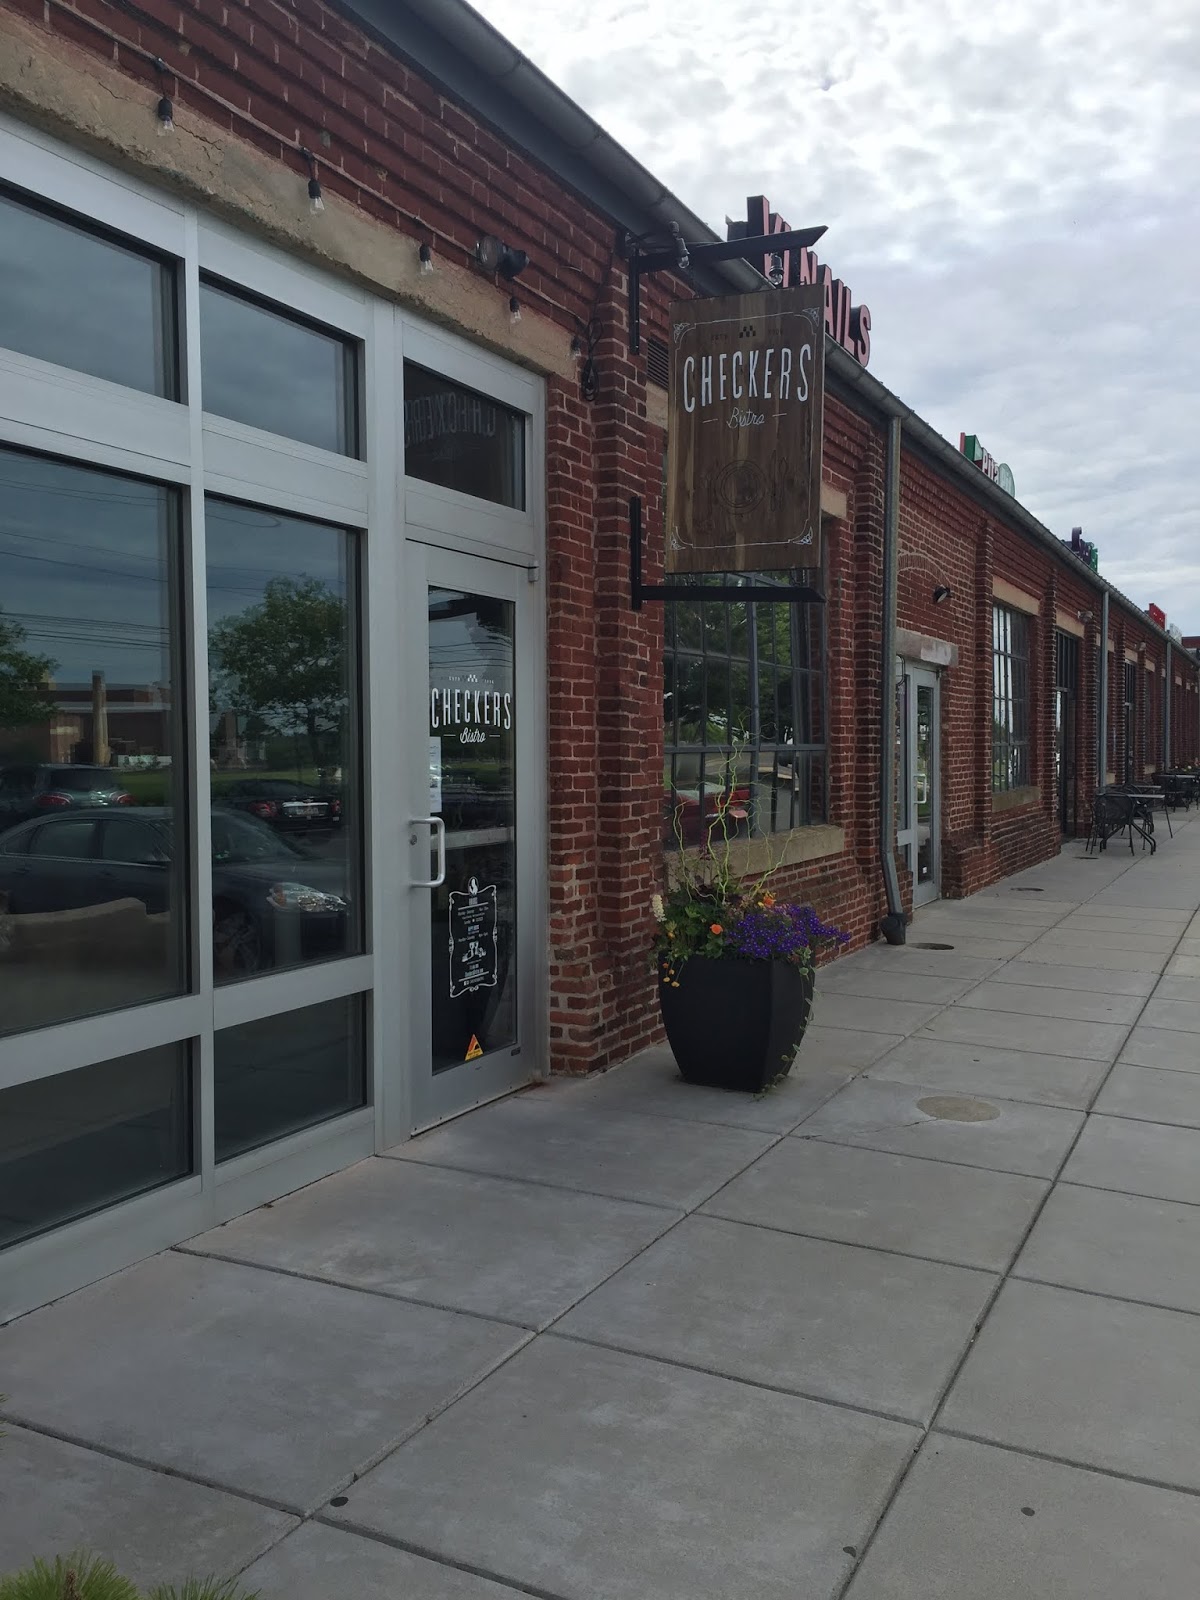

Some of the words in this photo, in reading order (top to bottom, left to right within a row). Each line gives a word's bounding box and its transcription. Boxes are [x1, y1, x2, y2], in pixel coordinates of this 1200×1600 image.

[682, 343, 812, 413] CHECKERS
[726, 406, 765, 429] Bistro
[431, 687, 511, 730] CHECKERS
[459, 727, 486, 744] Bistro
